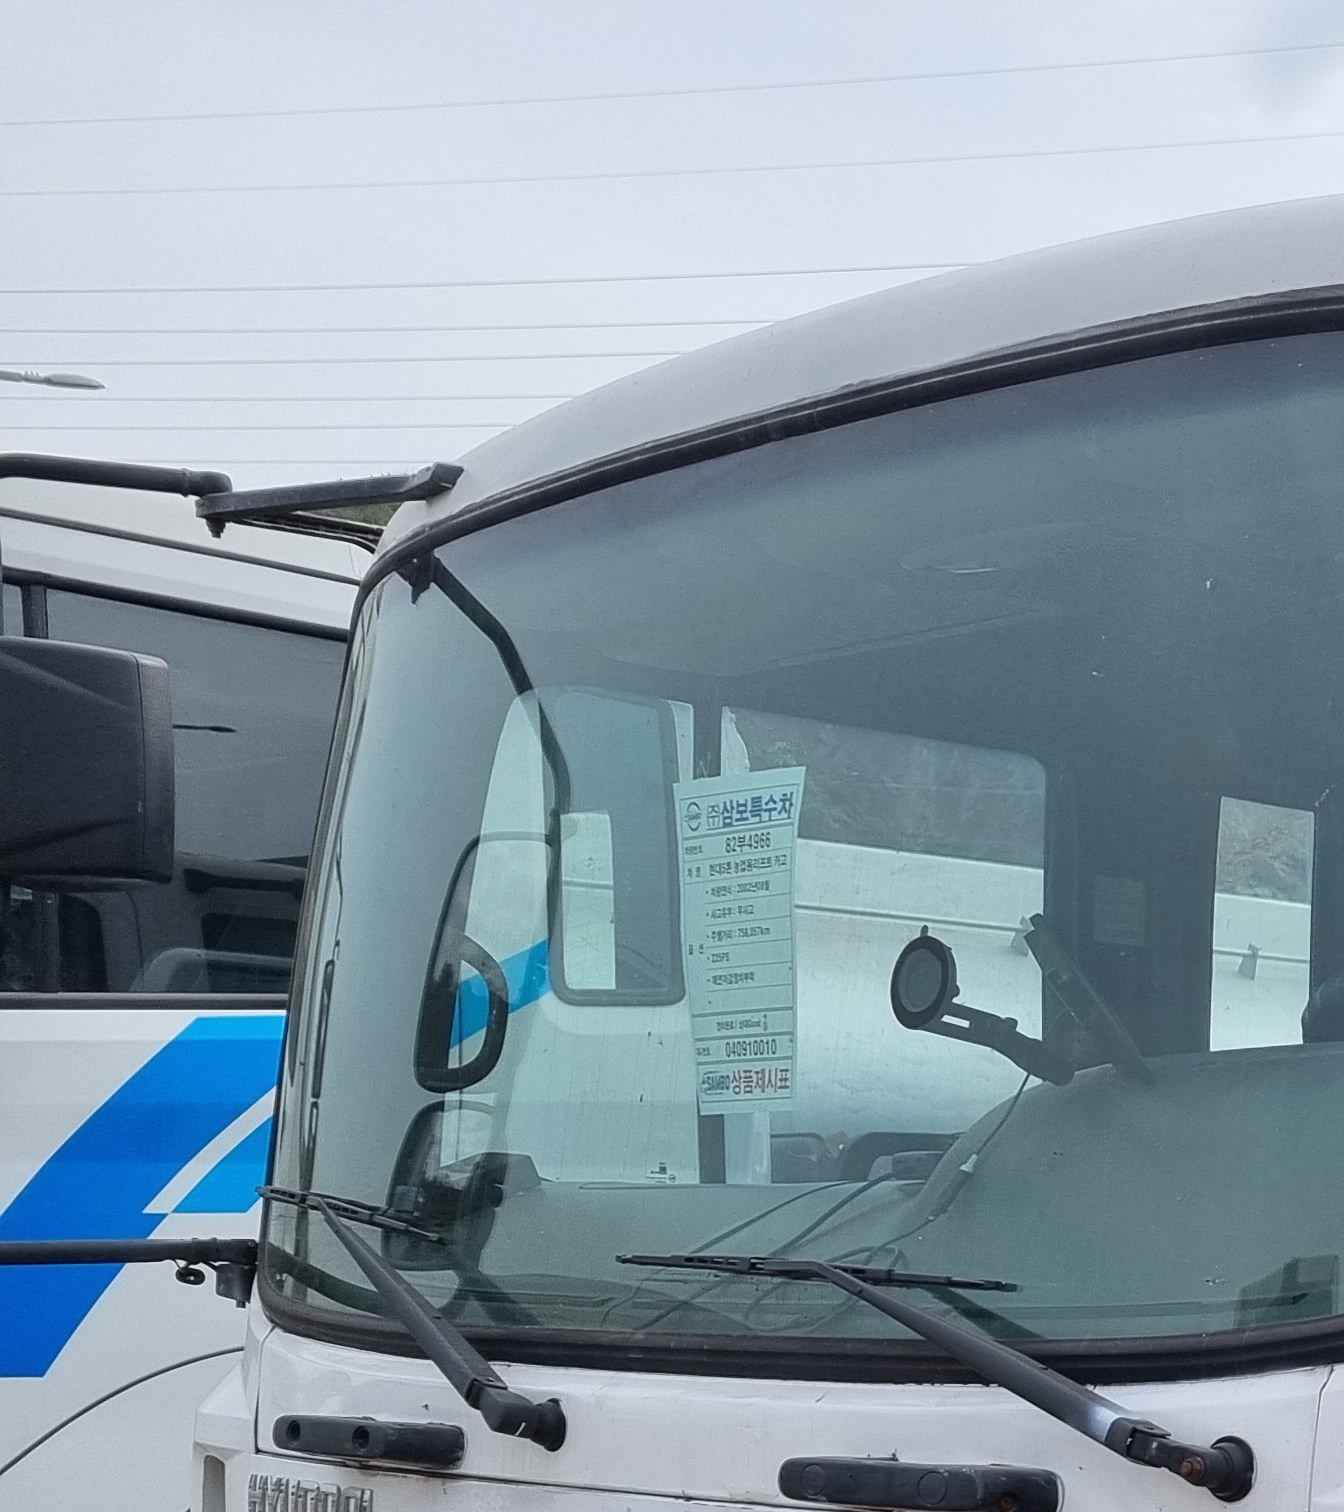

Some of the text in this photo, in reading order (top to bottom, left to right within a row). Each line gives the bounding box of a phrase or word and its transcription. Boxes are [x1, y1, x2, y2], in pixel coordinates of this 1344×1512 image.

[725, 831, 771, 854] 82부4966
[725, 1038, 777, 1058] 040910010
[731, 1067, 790, 1095] 상품제시표
